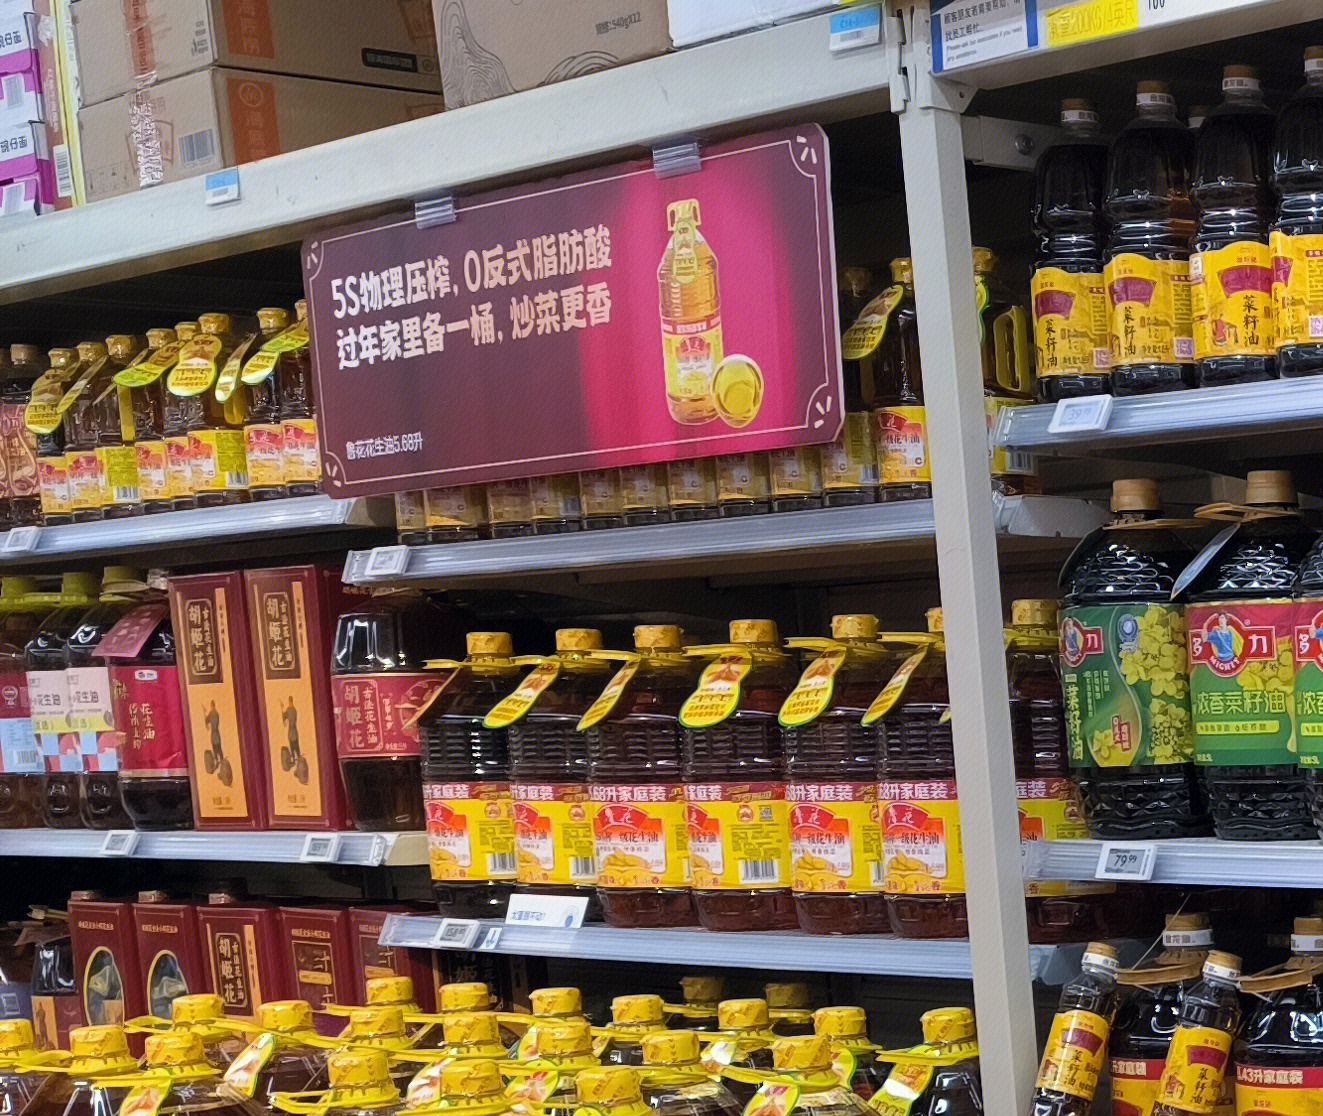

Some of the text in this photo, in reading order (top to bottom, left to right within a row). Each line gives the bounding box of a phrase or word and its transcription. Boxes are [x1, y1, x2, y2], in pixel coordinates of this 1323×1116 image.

[1241, 295, 1259, 347] 菜籽油
[268, 593, 282, 669] 胡姬花
